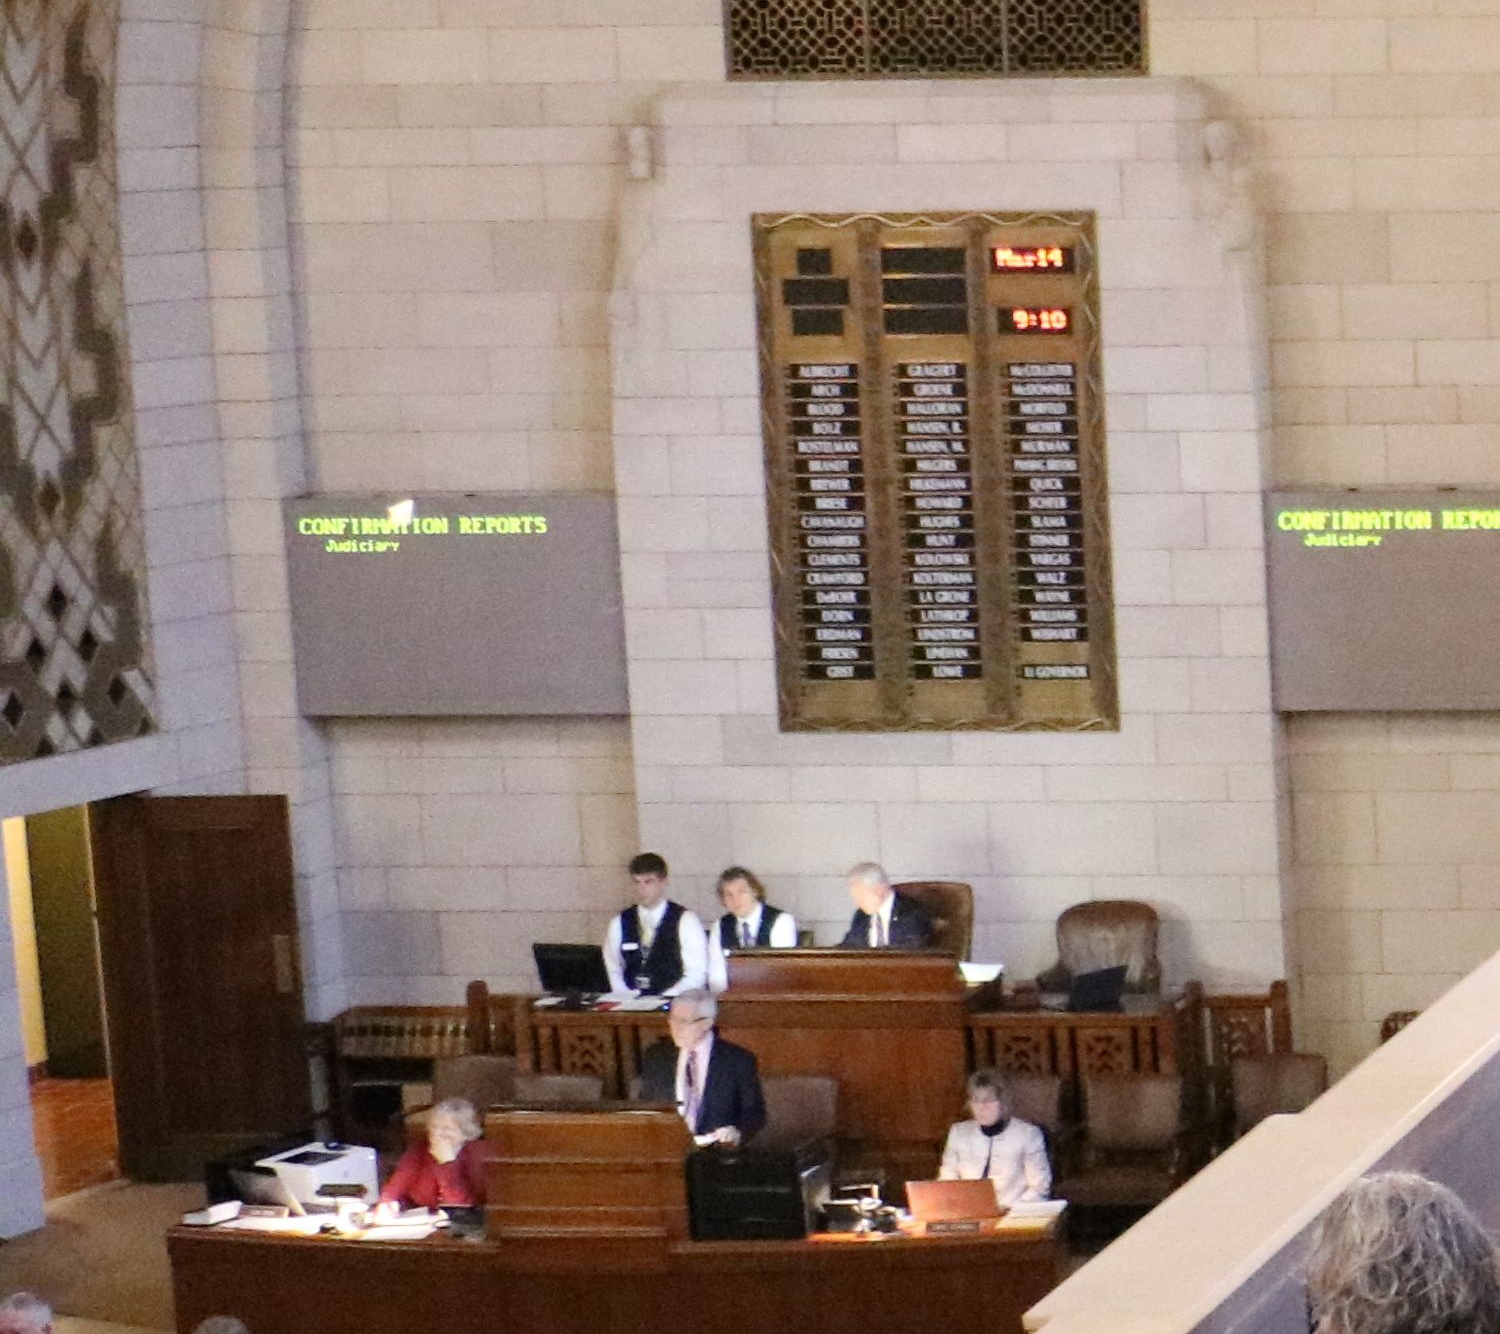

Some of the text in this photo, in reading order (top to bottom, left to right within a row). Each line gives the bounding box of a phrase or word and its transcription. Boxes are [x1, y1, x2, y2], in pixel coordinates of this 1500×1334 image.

[1012, 309, 1067, 329] 9:10
[298, 517, 547, 535] CONFIRMATION REPORTS
[1278, 511, 1432, 530] CONFIRMATION
[325, 539, 400, 553] Judiciary
[1304, 533, 1382, 547] Judiciary
